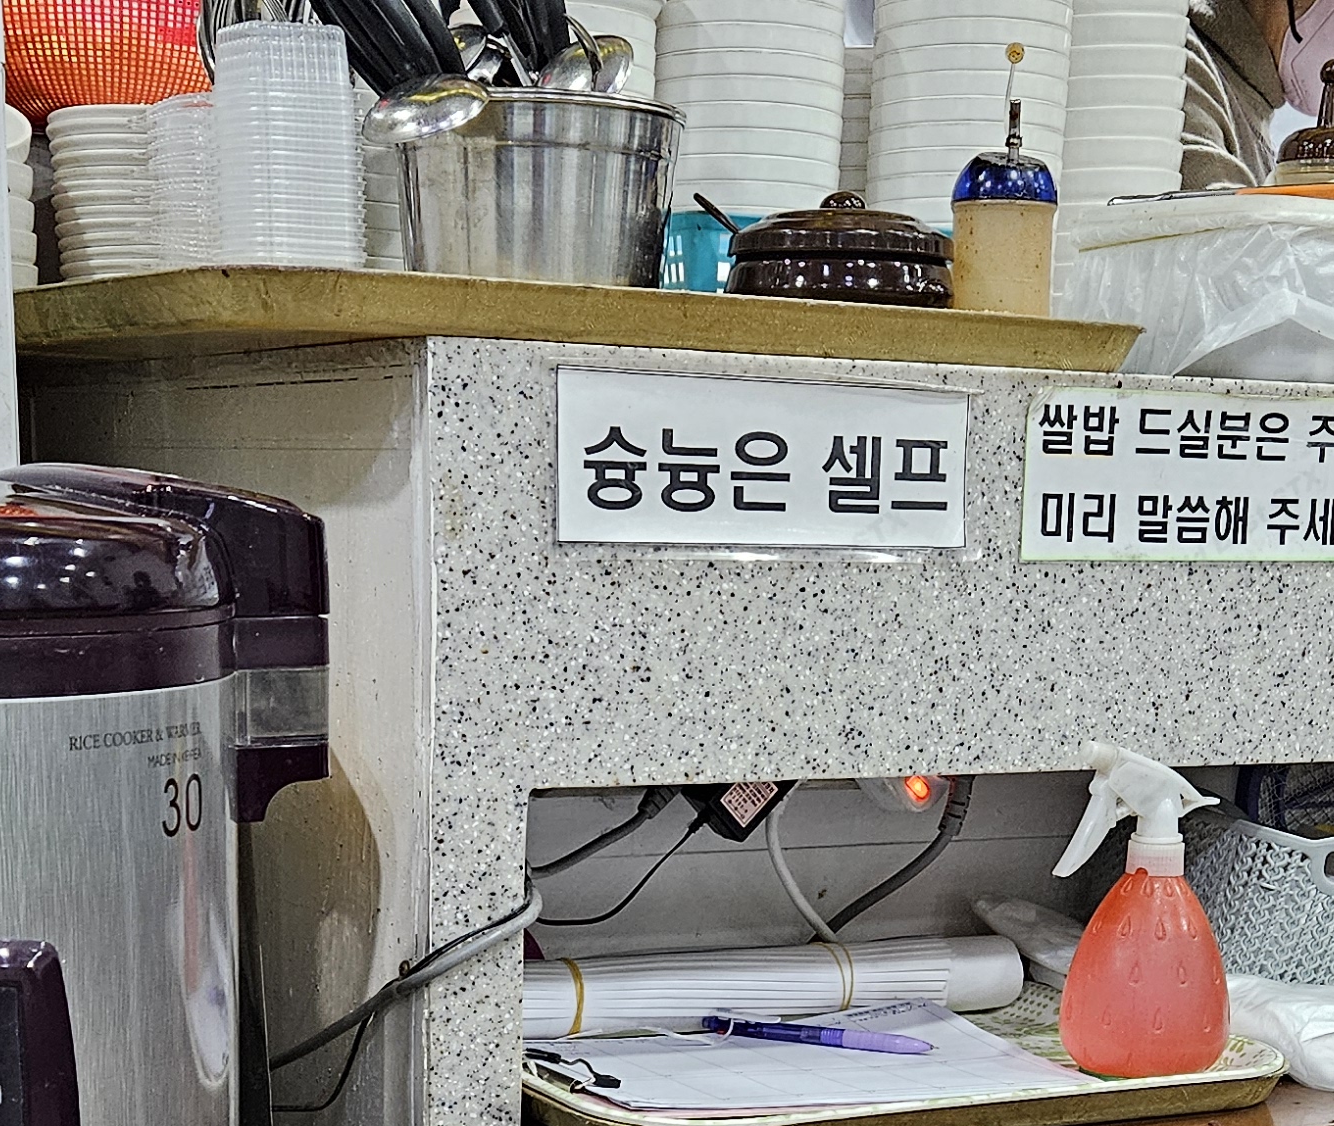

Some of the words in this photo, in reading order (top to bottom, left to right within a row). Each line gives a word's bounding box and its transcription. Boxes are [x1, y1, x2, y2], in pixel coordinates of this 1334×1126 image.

[1038, 403, 1120, 457] 쌀밥
[1134, 407, 1290, 461] 드실분은
[583, 426, 791, 512] 슝늉은
[821, 435, 949, 514] 셀프
[1040, 491, 1117, 543] 미리
[1136, 493, 1249, 546] 말씀해
[69, 733, 100, 751] RICE
[103, 729, 154, 748] COOKER
[155, 728, 164, 742] &
[162, 773, 202, 837] 30
